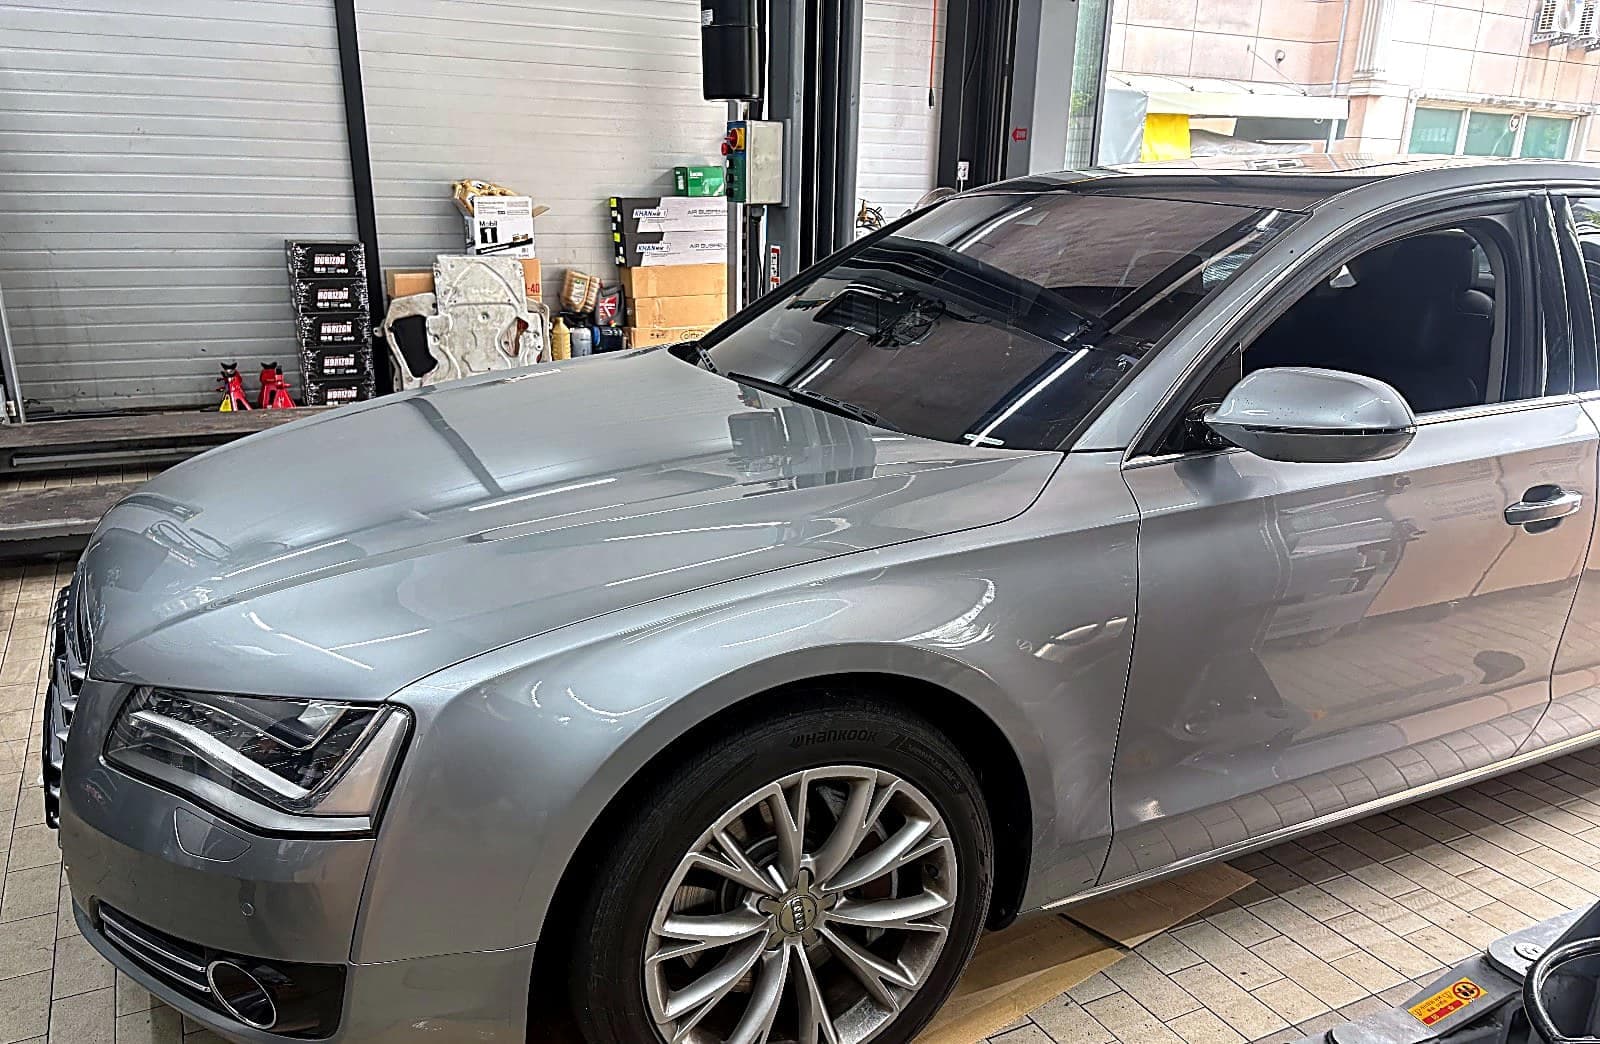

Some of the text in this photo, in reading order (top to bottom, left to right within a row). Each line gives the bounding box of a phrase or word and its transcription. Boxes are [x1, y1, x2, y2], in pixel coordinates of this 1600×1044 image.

[314, 256, 346, 265] HORIZON
[317, 290, 349, 300] HORIZON
[321, 325, 352, 334] HORIZON
[323, 357, 355, 367] HORIZON
[327, 389, 358, 399] HORIZON
